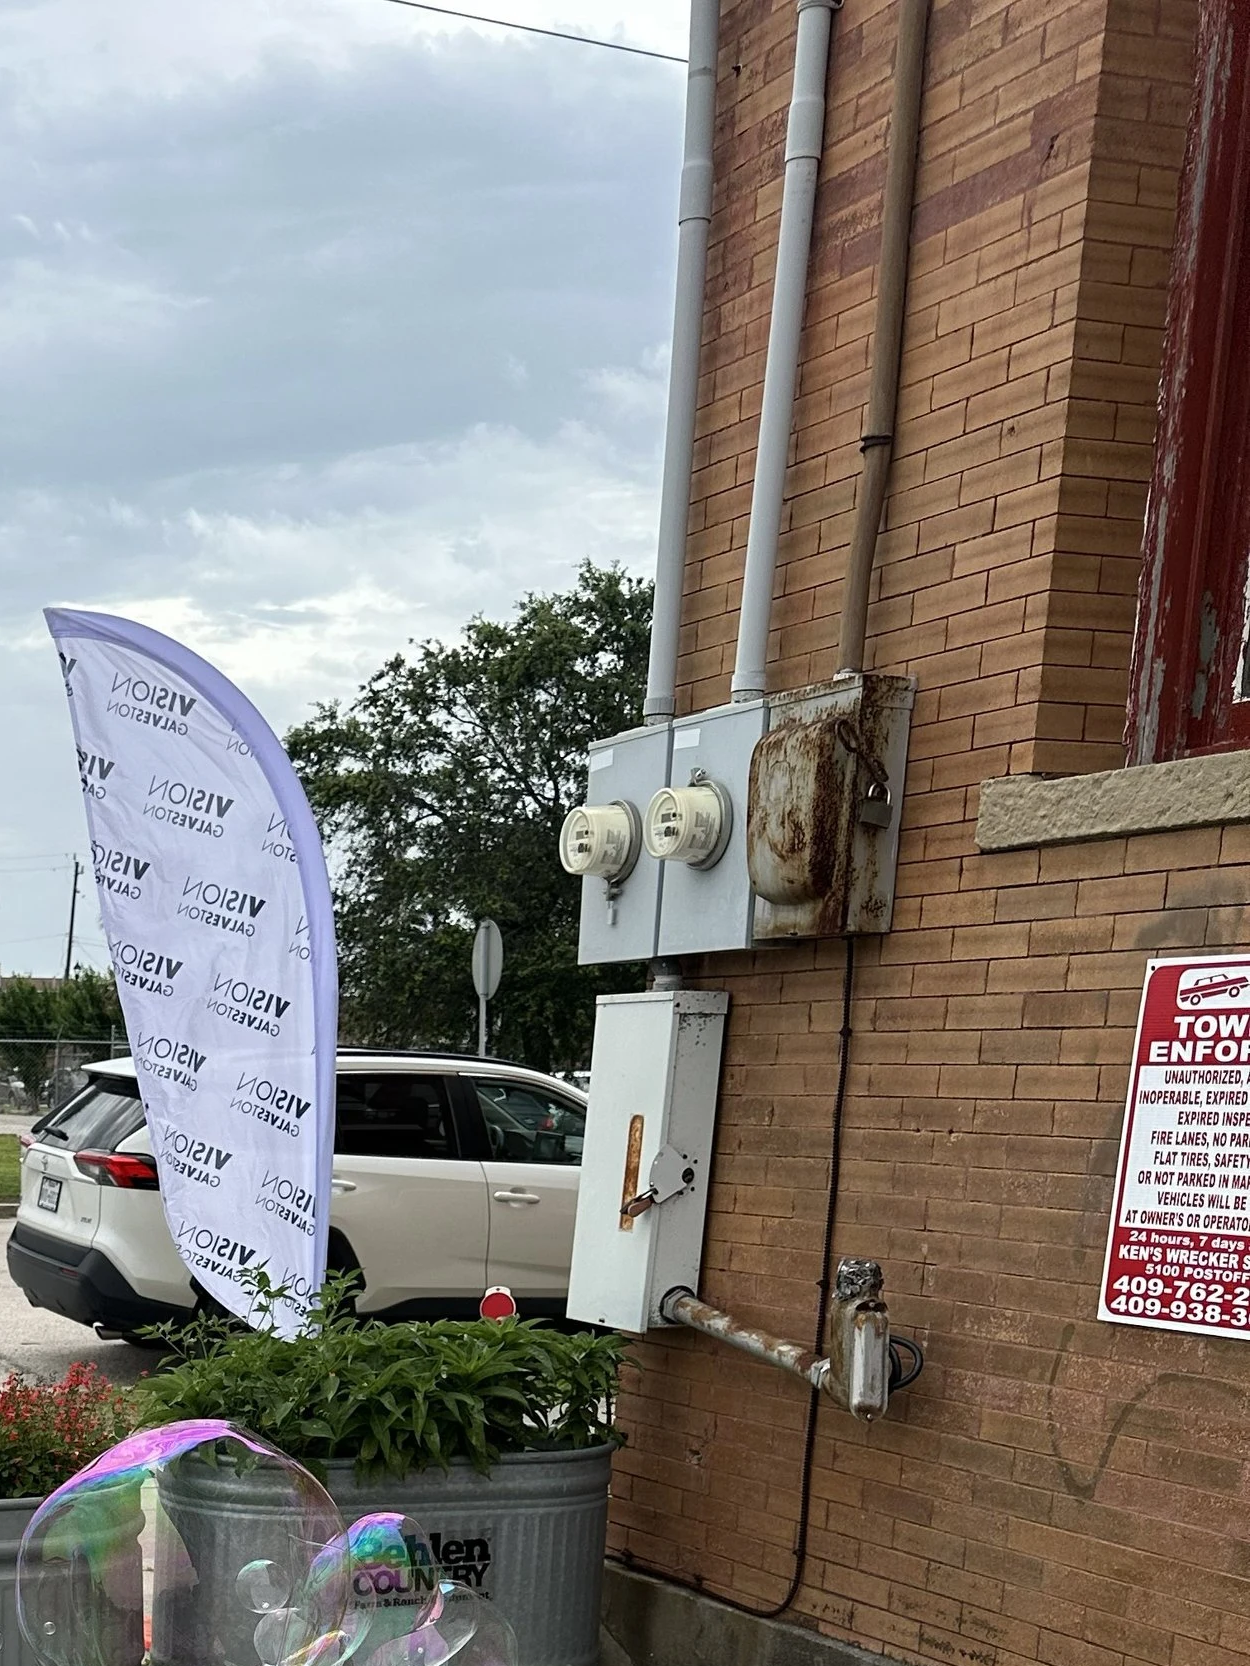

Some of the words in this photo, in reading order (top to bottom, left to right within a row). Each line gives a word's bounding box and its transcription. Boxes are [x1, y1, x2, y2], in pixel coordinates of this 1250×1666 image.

[1174, 1014, 1250, 1039] TOW
[1165, 1070, 1244, 1087] UNAUTHORIZED,
[1139, 1090, 1203, 1108] INOPERABLE,
[1206, 1091, 1248, 1106] EXPIRED
[1178, 1111, 1219, 1126] EXPIRED
[1151, 1130, 1173, 1145] FIRE
[1175, 1131, 1209, 1150] LANES,
[1213, 1132, 1227, 1147] NO
[1230, 1133, 1250, 1148] PAR
[1154, 1151, 1178, 1165] FLAT
[1181, 1152, 1210, 1170] TIRES,
[1138, 1171, 1151, 1185] OR
[1154, 1171, 1175, 1186] NOT
[1177, 1172, 1216, 1188] PARKED
[1218, 1174, 1230, 1189] IN
[1157, 1191, 1205, 1208] VEHICLES
[1208, 1194, 1230, 1209] WILL
[1233, 1196, 1247, 1211] BE
[1125, 1210, 1138, 1223] AT
[1140, 1210, 1184, 1227] OWNER'S
[1187, 1213, 1200, 1228] OR
[1203, 1215, 1250, 1232] OPERATO
[1129, 1230, 1147, 1242] 24
[1150, 1232, 1194, 1248] hours,
[1199, 1236, 1208, 1247] 7
[1211, 1237, 1245, 1252] days
[1119, 1244, 1162, 1262] KEN'S
[1166, 1248, 1239, 1269] WRECKER
[1145, 1263, 1180, 1277] 5100
[1112, 1275, 1250, 1307] 409-762-2
[1110, 1294, 1250, 1327] 409-938-3
